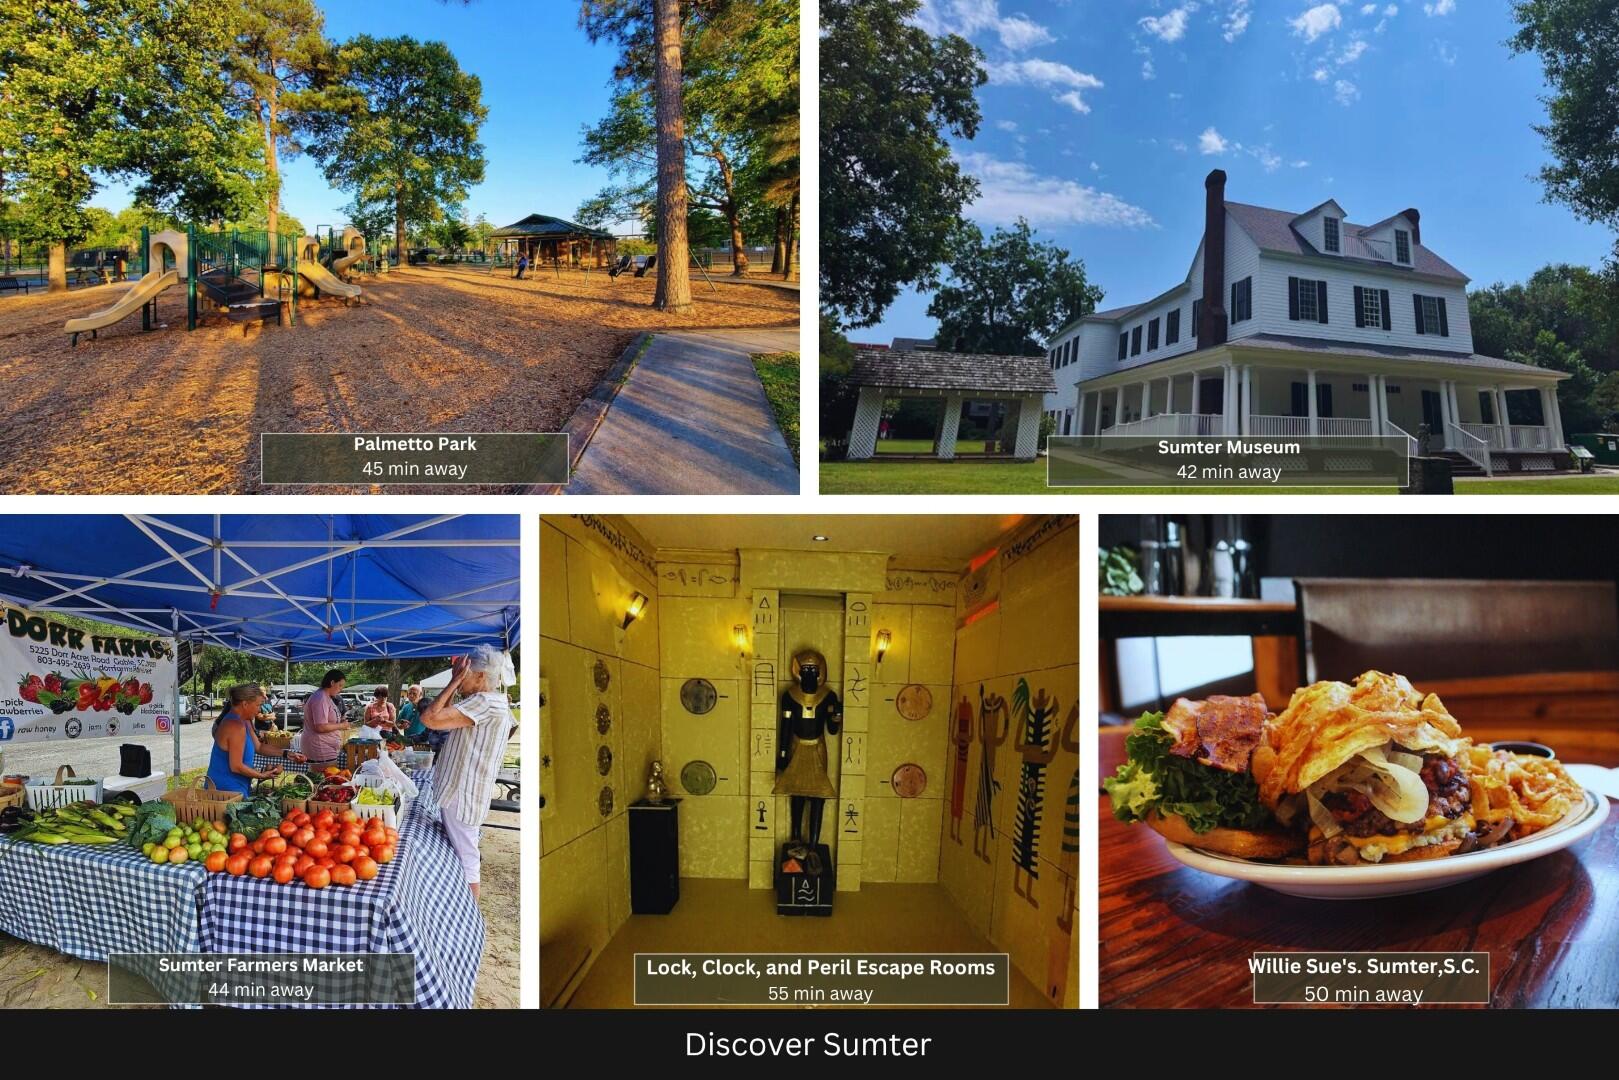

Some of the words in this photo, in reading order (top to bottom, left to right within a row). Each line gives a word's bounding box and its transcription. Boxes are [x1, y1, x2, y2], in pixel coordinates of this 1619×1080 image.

[7, 609, 84, 651] DORR
[91, 635, 164, 659] FARMS
[30, 645, 49, 656] 5225
[52, 648, 68, 659] Dorr
[91, 655, 110, 665] Road
[37, 655, 91, 670] 803-495-2639
[17, 726, 33, 734] raw
[35, 724, 57, 733] honey
